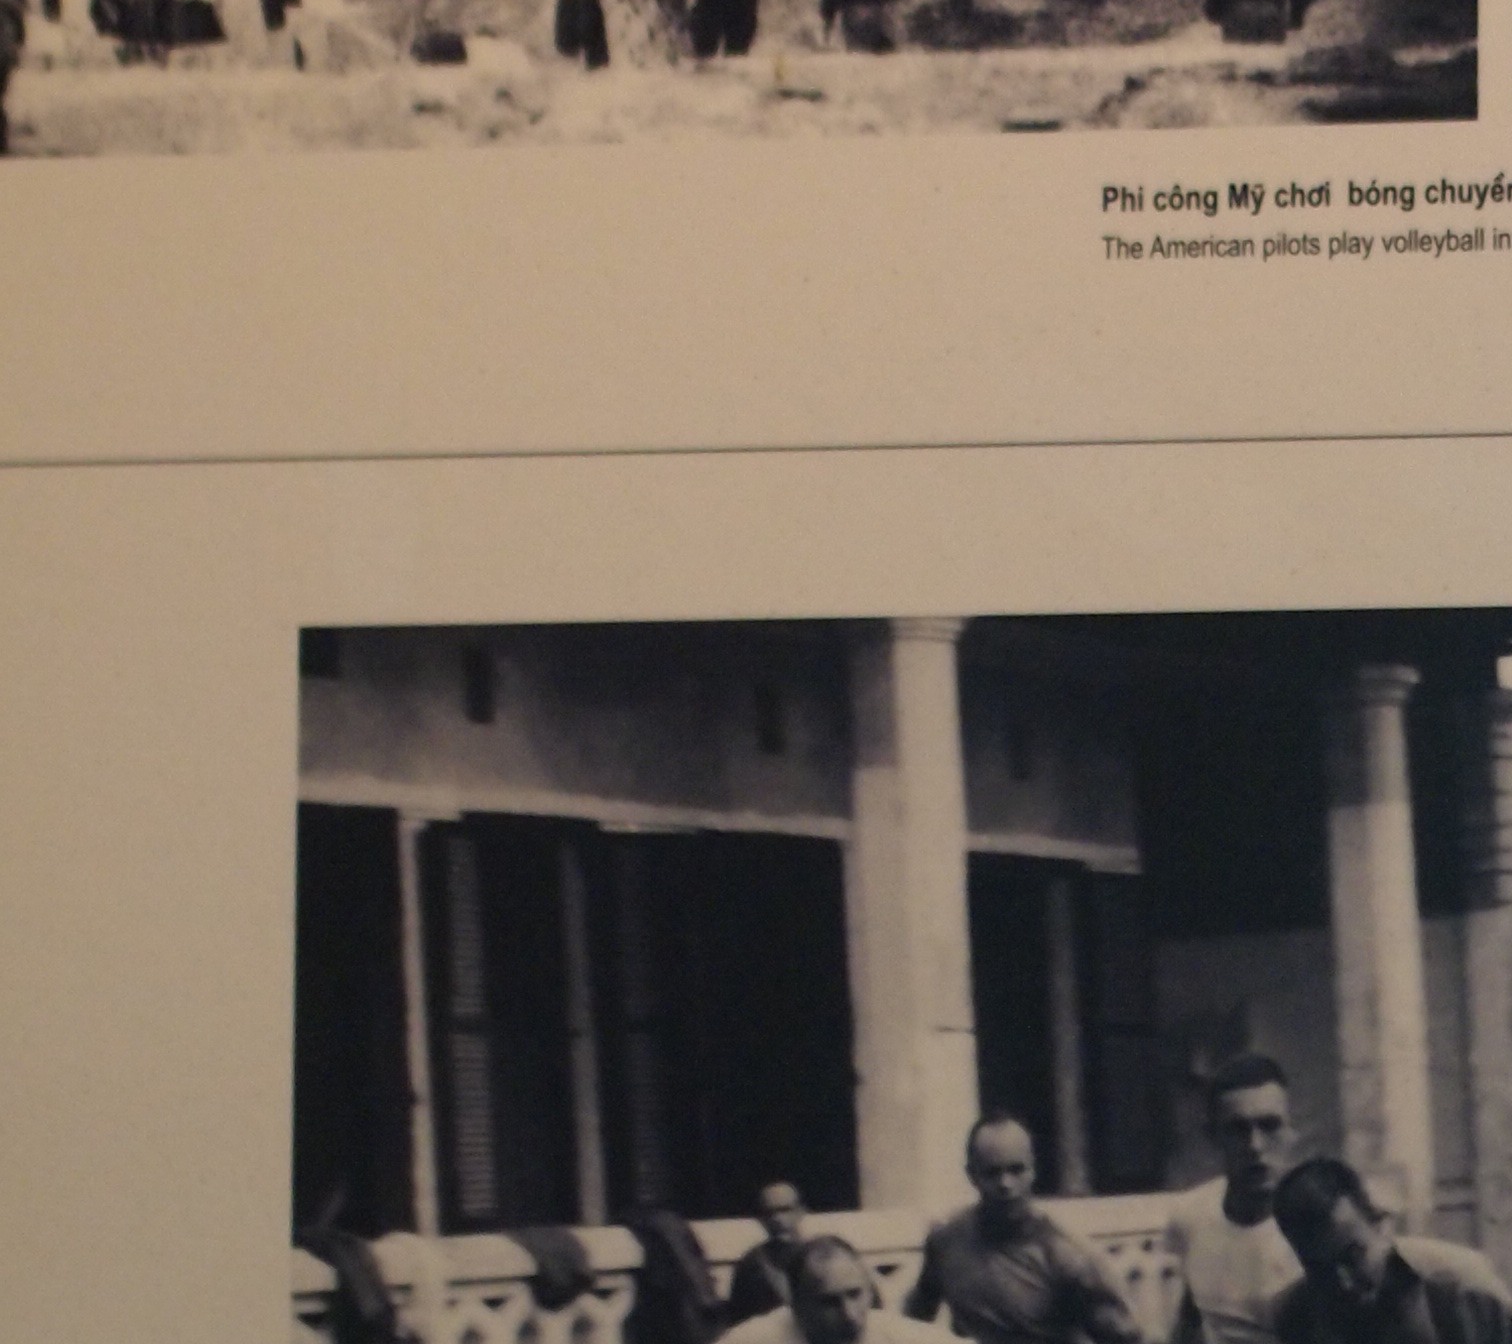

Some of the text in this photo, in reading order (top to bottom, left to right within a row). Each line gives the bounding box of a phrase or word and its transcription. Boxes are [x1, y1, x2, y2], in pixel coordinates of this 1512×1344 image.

[1102, 185, 1144, 213] Phi
[1152, 183, 1219, 217] công
[1228, 182, 1266, 216] Mỹ
[1274, 181, 1331, 209] chơi
[1348, 178, 1416, 212] bóng
[1101, 234, 1144, 260] The
[1150, 234, 1256, 260] American
[1263, 233, 1321, 262] pilots
[1328, 231, 1375, 260] play
[1381, 227, 1486, 258] volleyball
[1492, 227, 1512, 251] in
